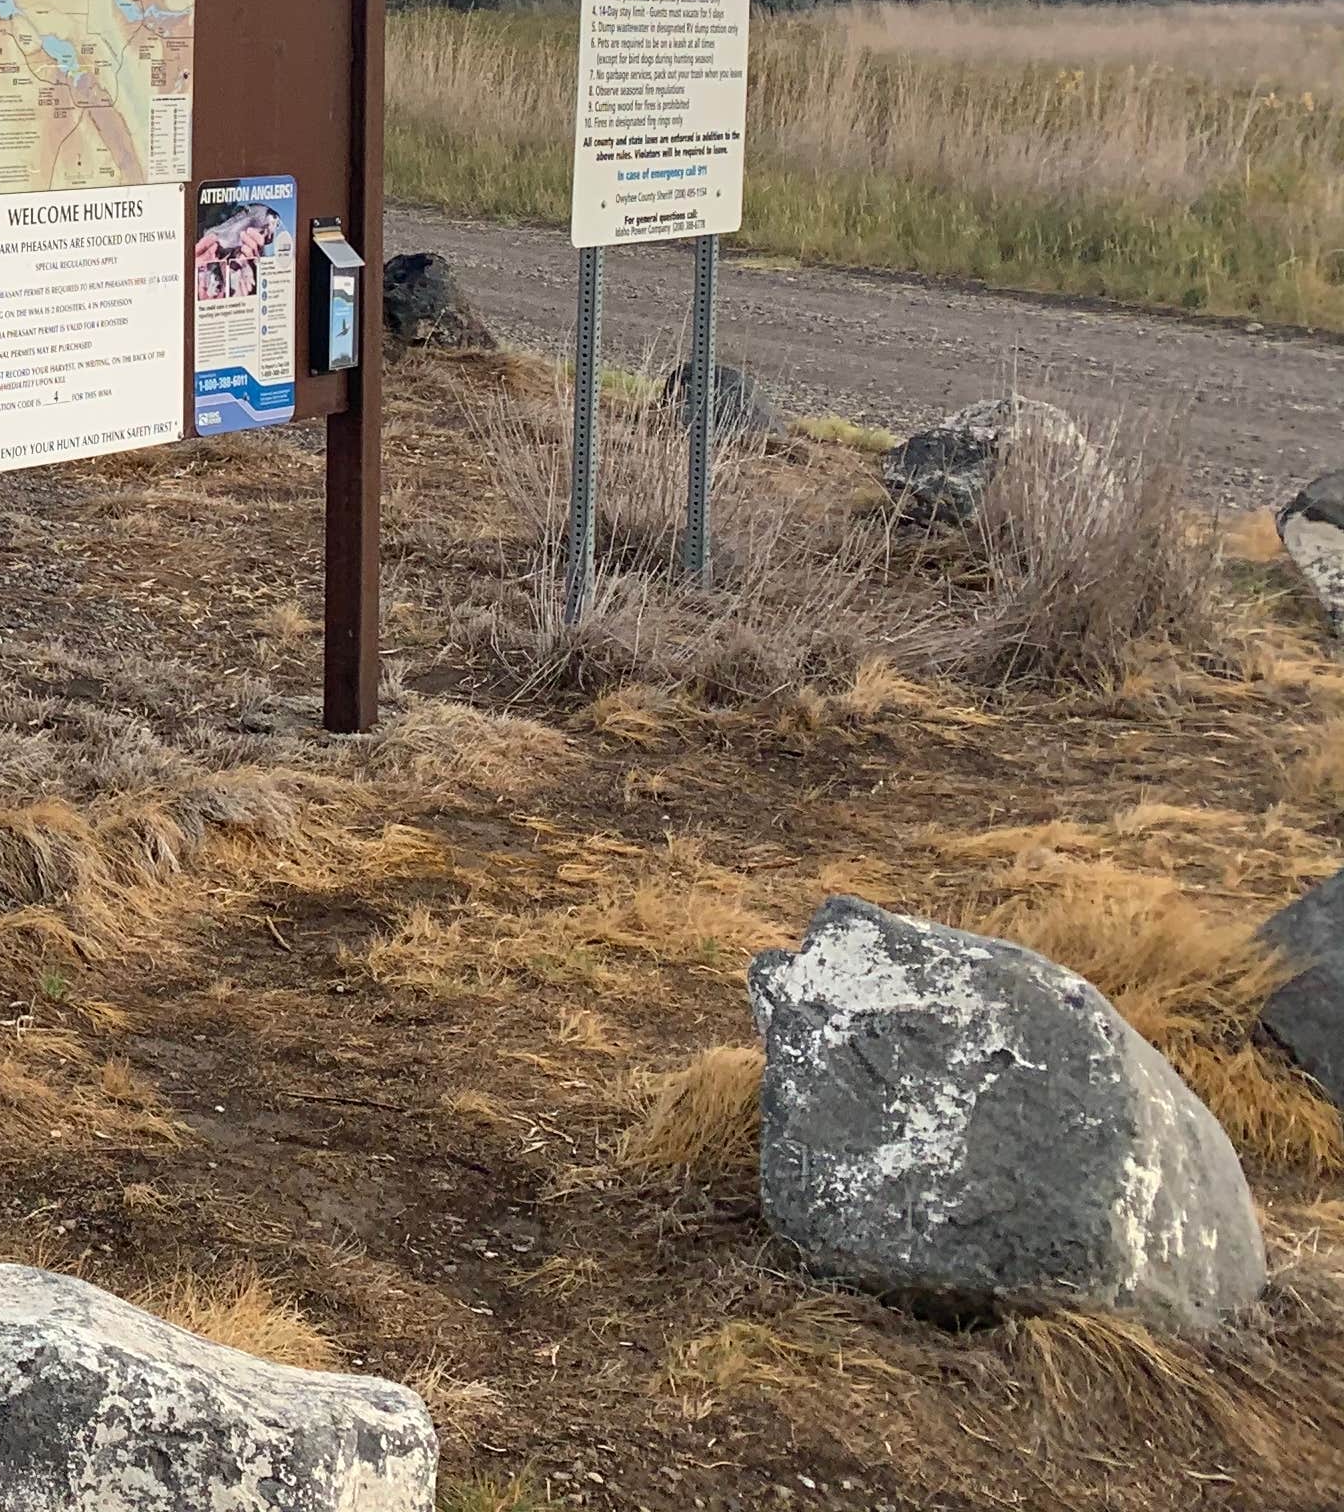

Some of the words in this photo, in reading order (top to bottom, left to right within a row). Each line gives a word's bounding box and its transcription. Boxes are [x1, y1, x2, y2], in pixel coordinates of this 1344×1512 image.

[626, 171, 640, 180] case
[650, 168, 684, 181] emergency
[199, 186, 250, 204] ATTENTION
[250, 183, 293, 201] ANGLERS!
[8, 204, 80, 226] WELCOME
[83, 199, 144, 221] HUNTERS
[21, 239, 68, 253] PHEASANTS
[70, 237, 85, 249] ARE
[86, 234, 123, 247] STOCKED
[124, 233, 138, 244] ON
[139, 231, 155, 242] THIS
[156, 230, 177, 240] WMA
[35, 261, 59, 272] SPECIAL
[60, 258, 100, 270] REGULATIONS
[100, 256, 118, 267] APPLY
[0, 443, 27, 459] ENJOY
[30, 439, 54, 455] YOUR
[56, 435, 80, 451] HUNT
[81, 432, 100, 447] AND
[101, 429, 125, 444] THINK
[126, 425, 151, 440] SAFETY
[153, 422, 172, 436] FIRST
